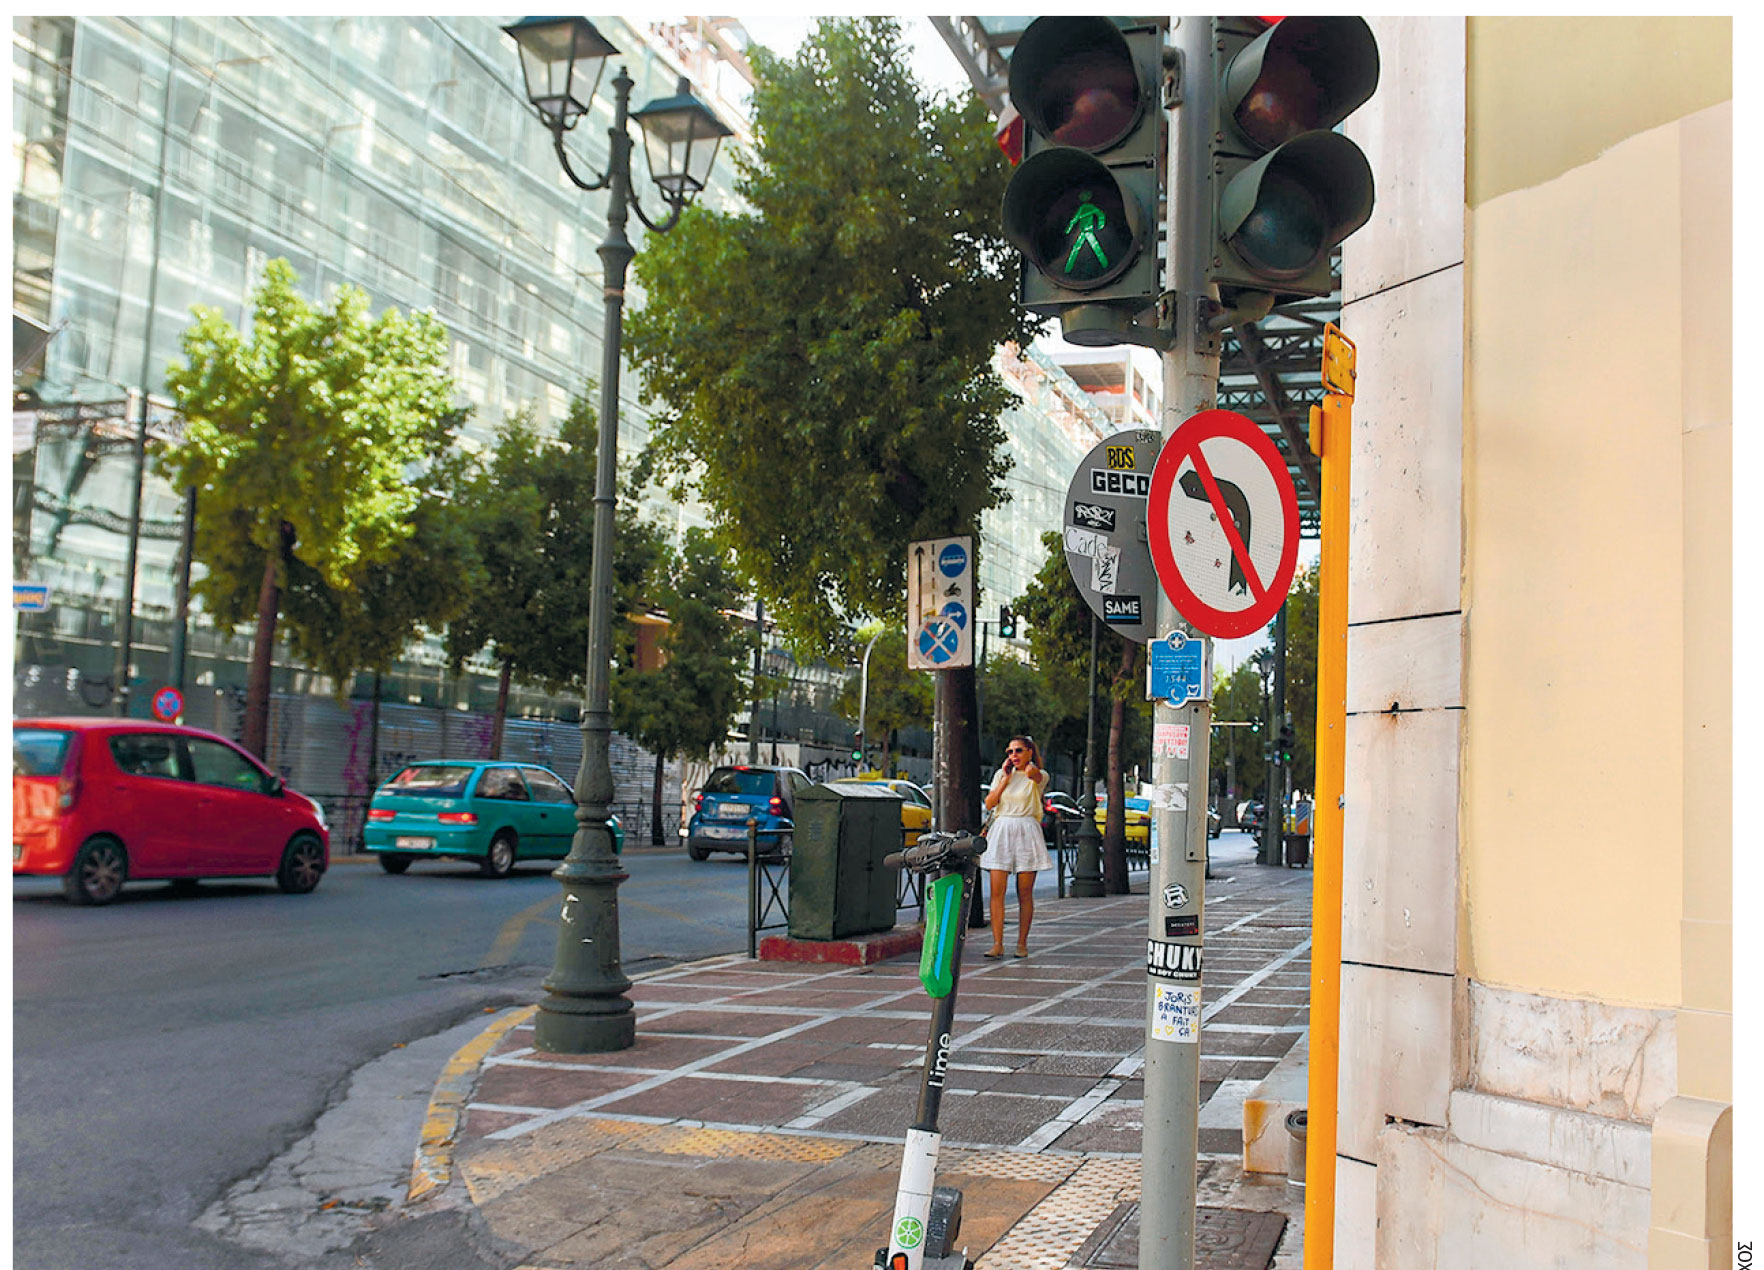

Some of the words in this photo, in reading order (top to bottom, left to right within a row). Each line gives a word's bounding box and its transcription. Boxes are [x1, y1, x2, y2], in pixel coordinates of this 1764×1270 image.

[1105, 600, 1139, 615] SAME
[1148, 940, 1202, 970] CHUKY
[928, 1033, 950, 1087] Lime
